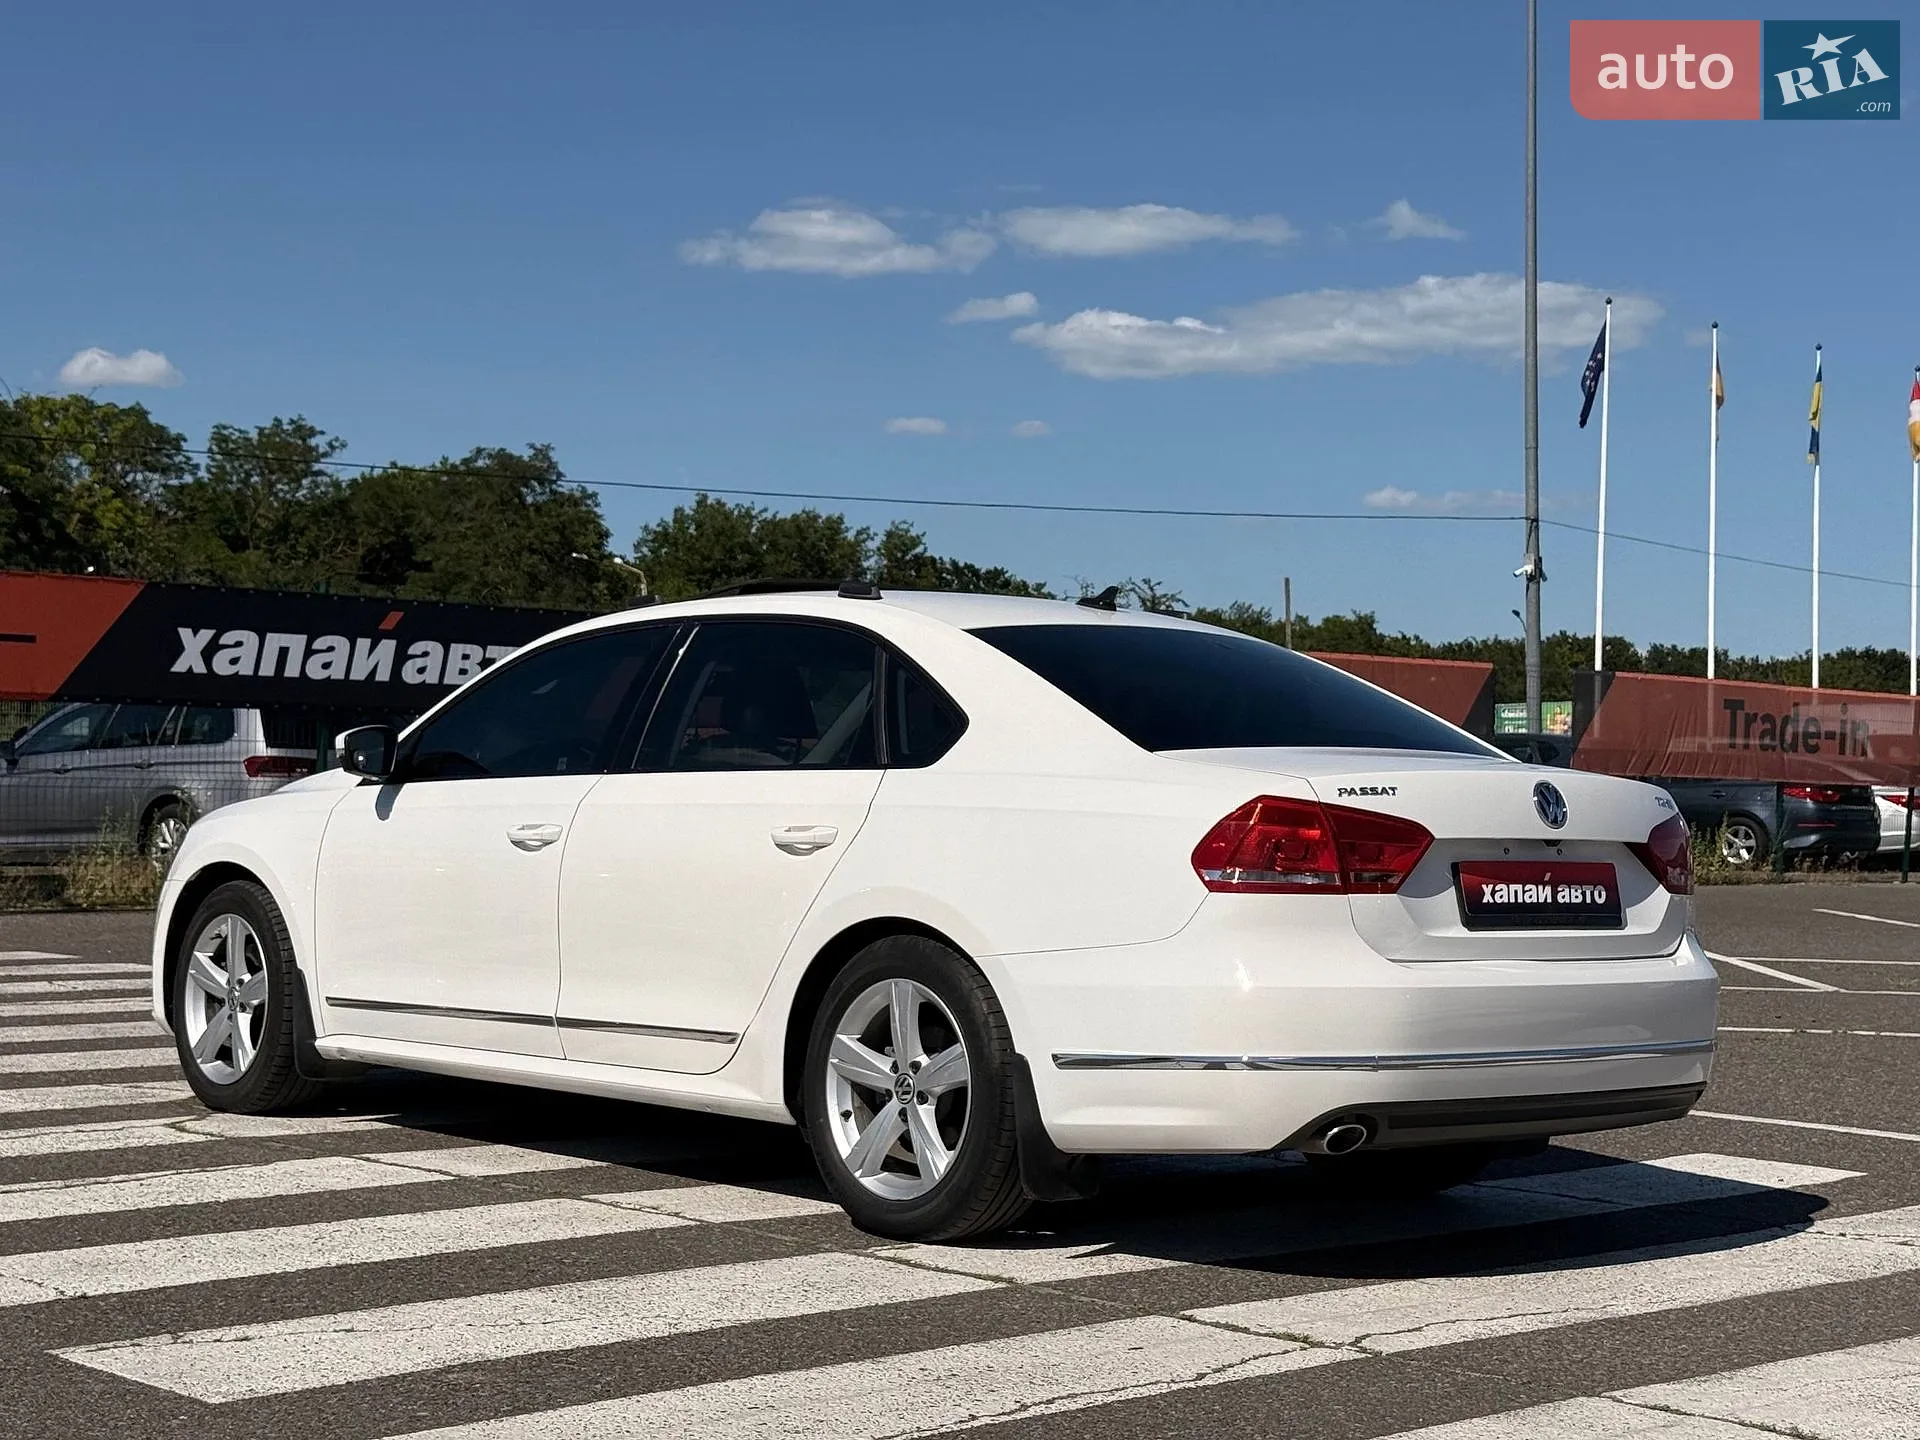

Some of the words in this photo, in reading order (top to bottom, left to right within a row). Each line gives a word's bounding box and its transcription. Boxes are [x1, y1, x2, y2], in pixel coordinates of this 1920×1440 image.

[169, 611, 405, 683] хапай
[401, 640, 523, 686] авт
[1723, 698, 1871, 757] Trade-in
[1336, 786, 1398, 798] PASSAT
[1481, 872, 1552, 904] хапай
[1556, 884, 1607, 905] авто
